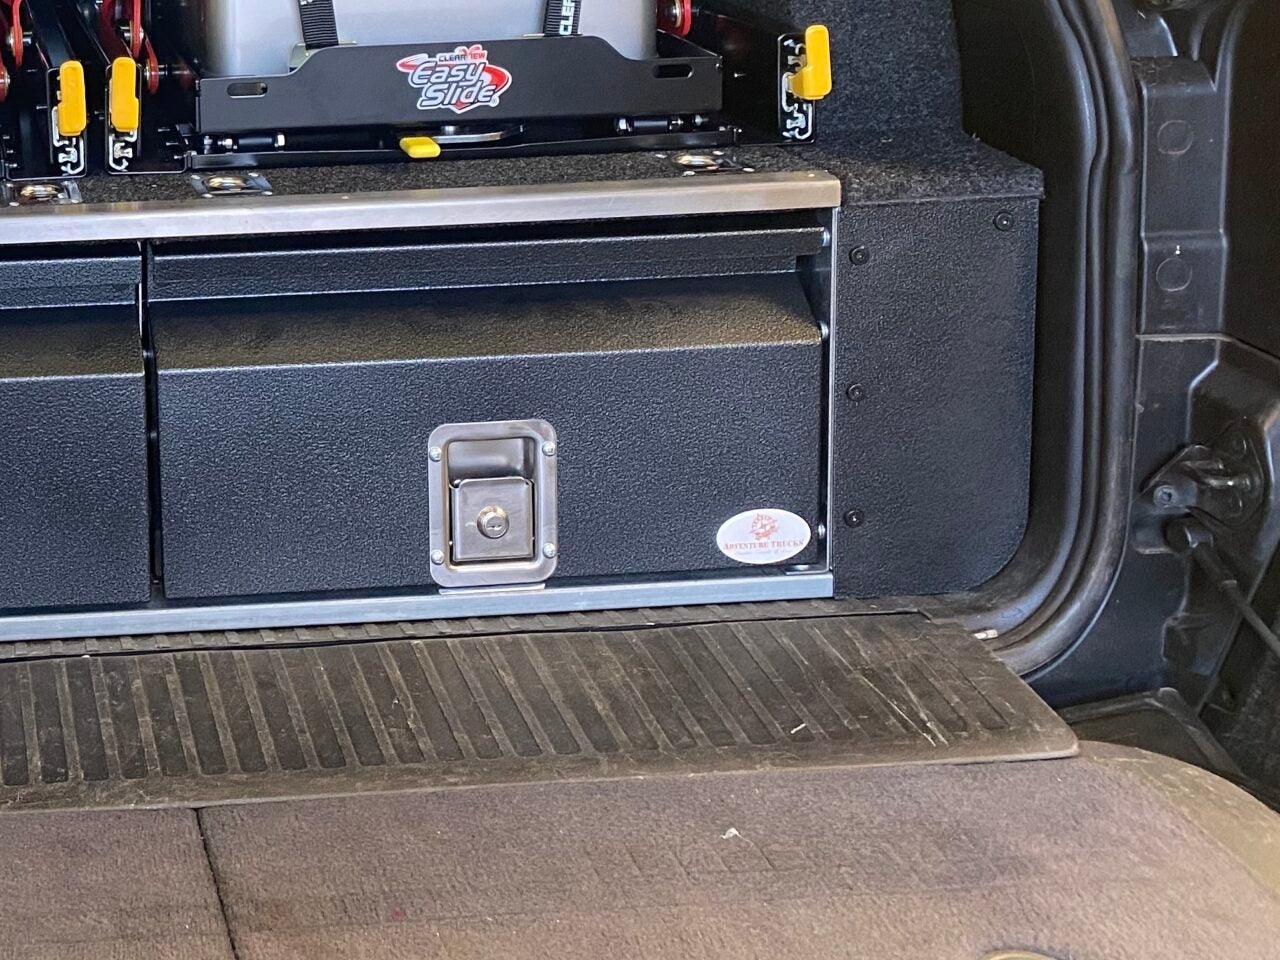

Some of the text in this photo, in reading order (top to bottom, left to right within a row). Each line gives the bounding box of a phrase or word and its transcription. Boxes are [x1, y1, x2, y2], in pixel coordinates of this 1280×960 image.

[411, 61, 487, 86] Easy
[420, 81, 498, 106] Slide
[772, 540, 804, 548] TRUCKS
